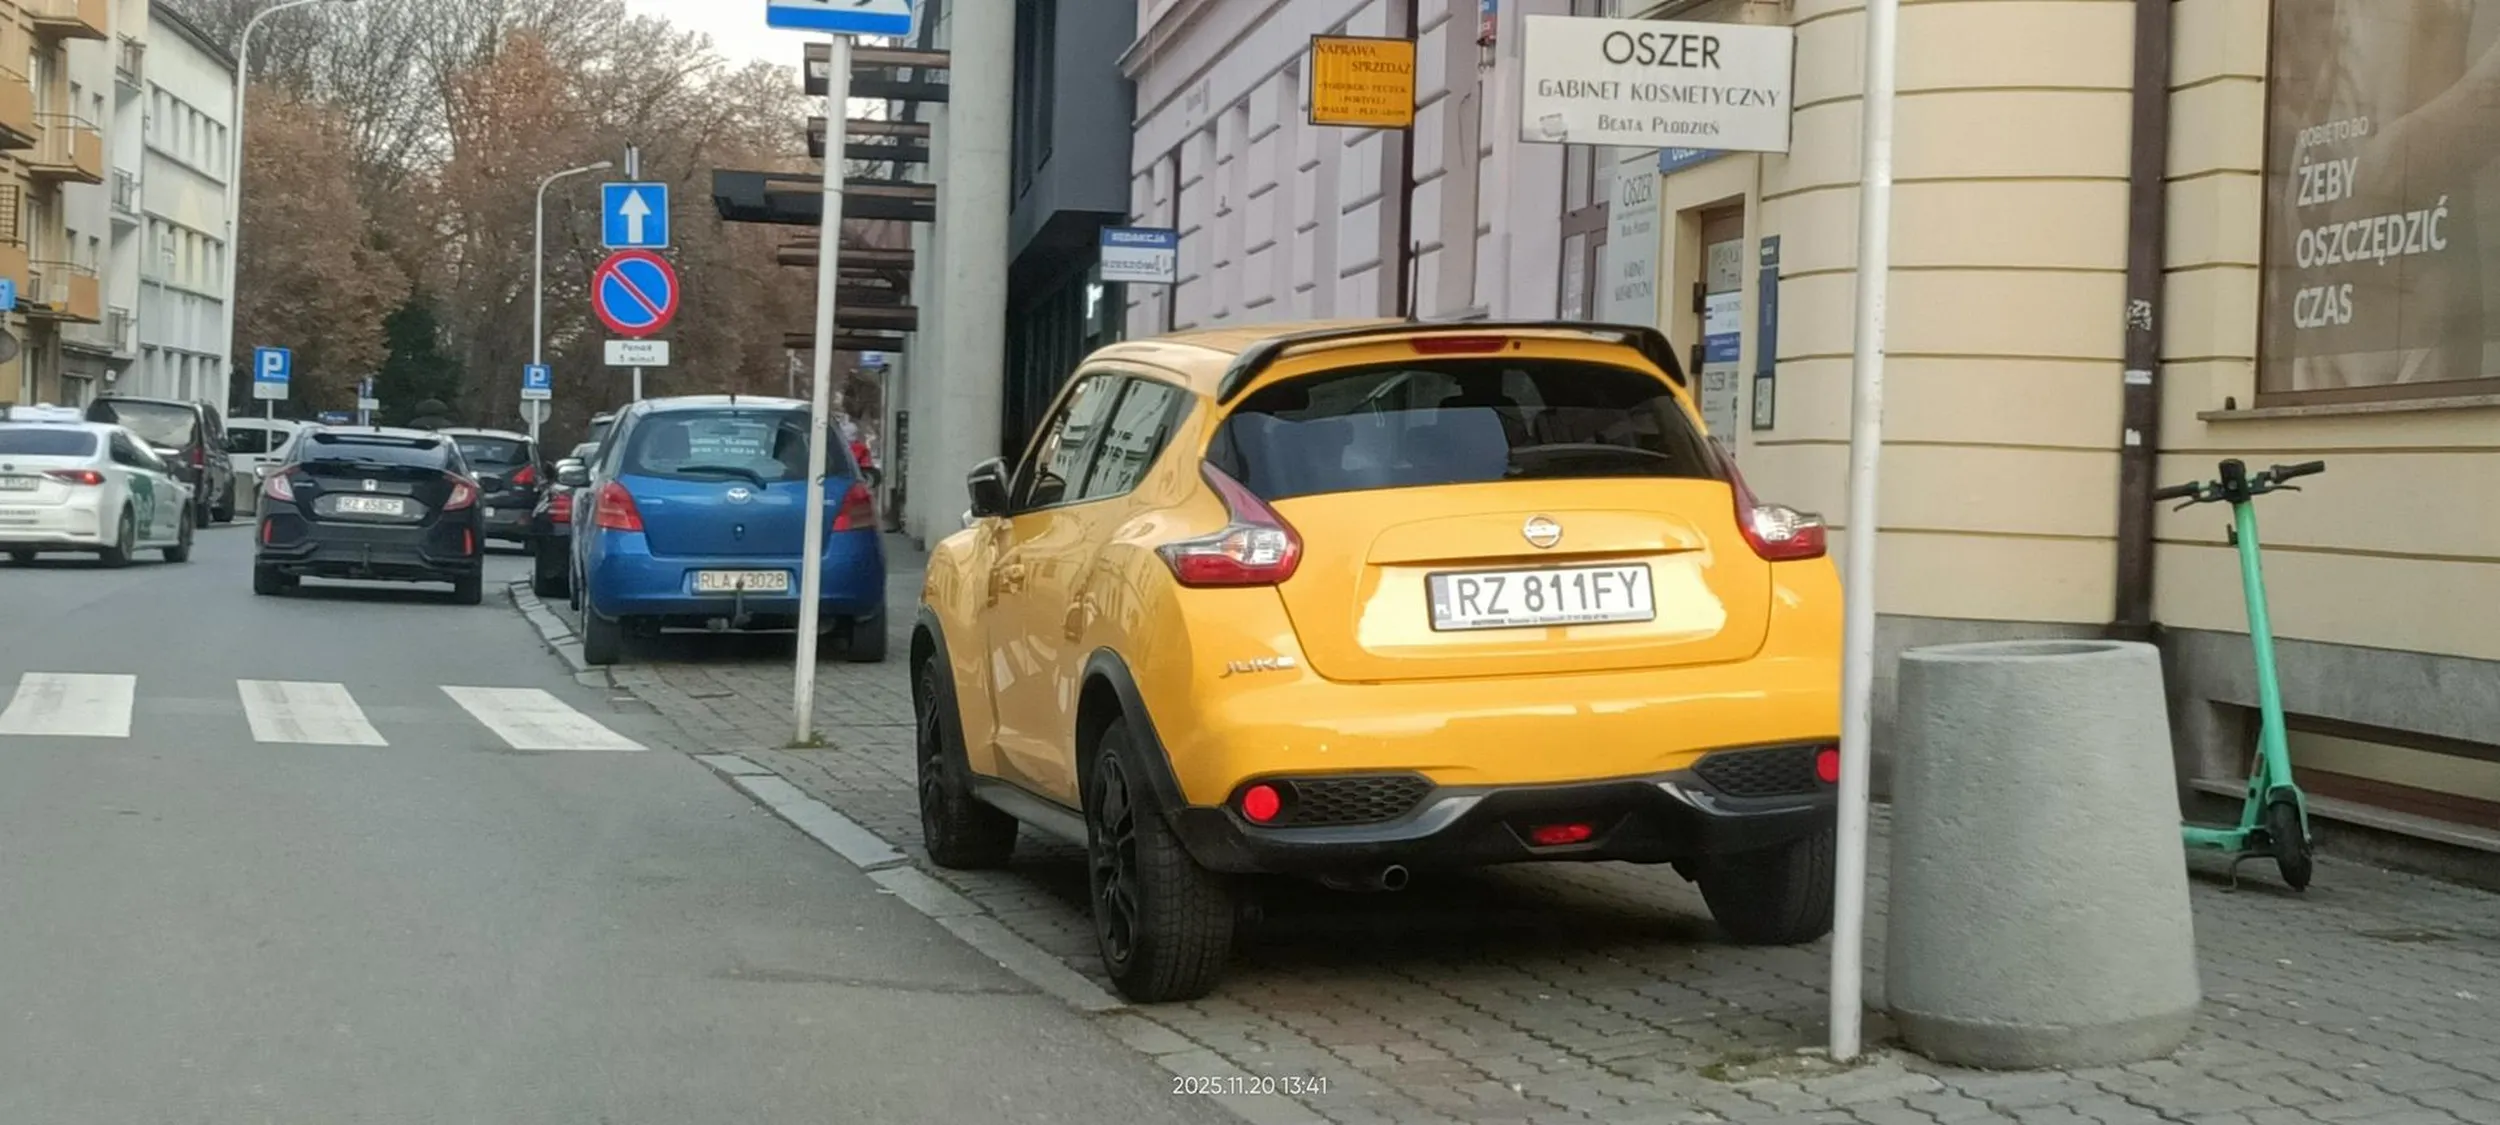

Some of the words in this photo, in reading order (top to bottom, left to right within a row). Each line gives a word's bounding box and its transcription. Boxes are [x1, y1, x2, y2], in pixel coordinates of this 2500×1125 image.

[1317, 42, 1376, 57] NAPRAWA
[1602, 29, 1721, 70] OSZER
[1537, 78, 1620, 102] GABINET
[1630, 82, 1781, 108] KOSMETYCZNY
[2350, 115, 2370, 138] BO
[2296, 155, 2357, 207] ŻEBY
[2295, 194, 2449, 269] OSZCZĘDZIĆ
[2293, 282, 2353, 329] CZAS
[700, 572, 731, 588] RLA
[1456, 575, 1510, 617] RZ
[1522, 569, 1640, 613] 811FY
